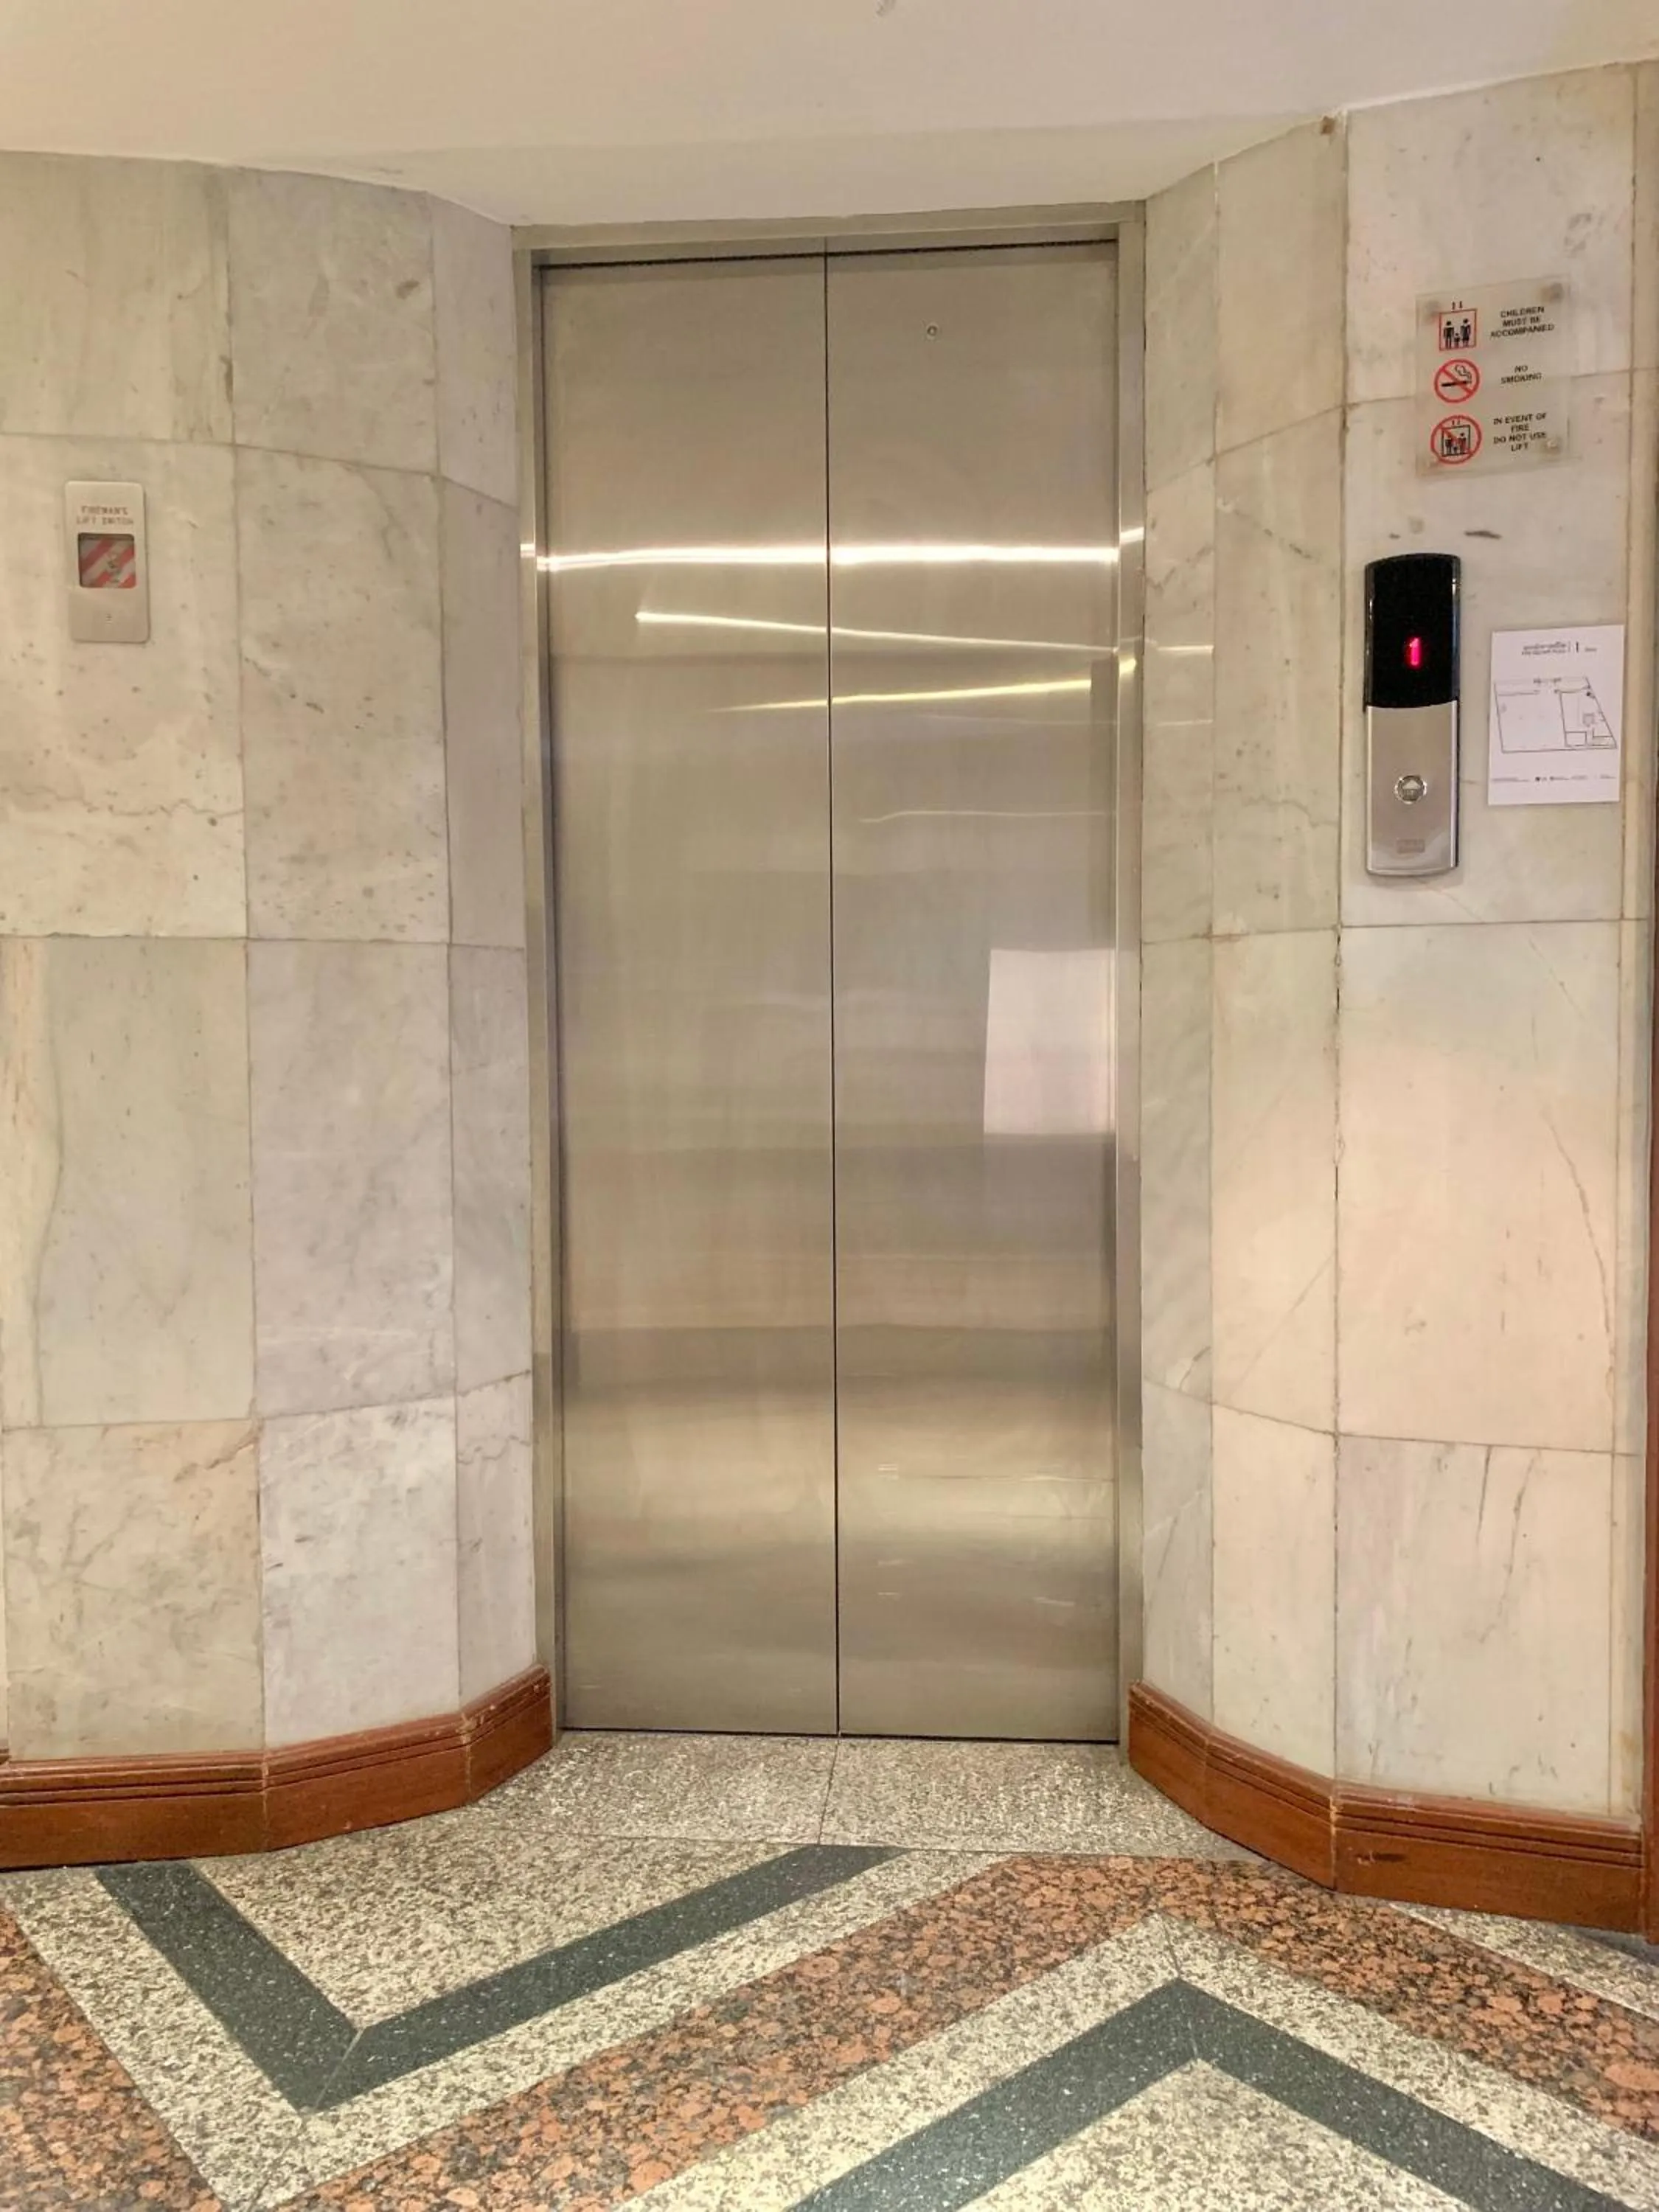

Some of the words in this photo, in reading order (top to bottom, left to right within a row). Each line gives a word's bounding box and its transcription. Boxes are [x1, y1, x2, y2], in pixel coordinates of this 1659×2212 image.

[1500, 306, 1545, 318] CHILDREN
[1503, 317, 1526, 327] MUST
[1530, 316, 1540, 324] BE
[1490, 324, 1555, 338] ACCOMPANIED
[1500, 372, 1543, 384] SMOKING
[1505, 414, 1533, 424] EVENT
[1536, 412, 1547, 420] OF
[1511, 423, 1530, 433] FIRE
[1493, 436, 1506, 444] DO
[1509, 433, 1527, 442] NOT
[1530, 431, 1547, 440] USE
[1511, 442, 1528, 452] LIFT
[1409, 636, 1422, 667] 1
